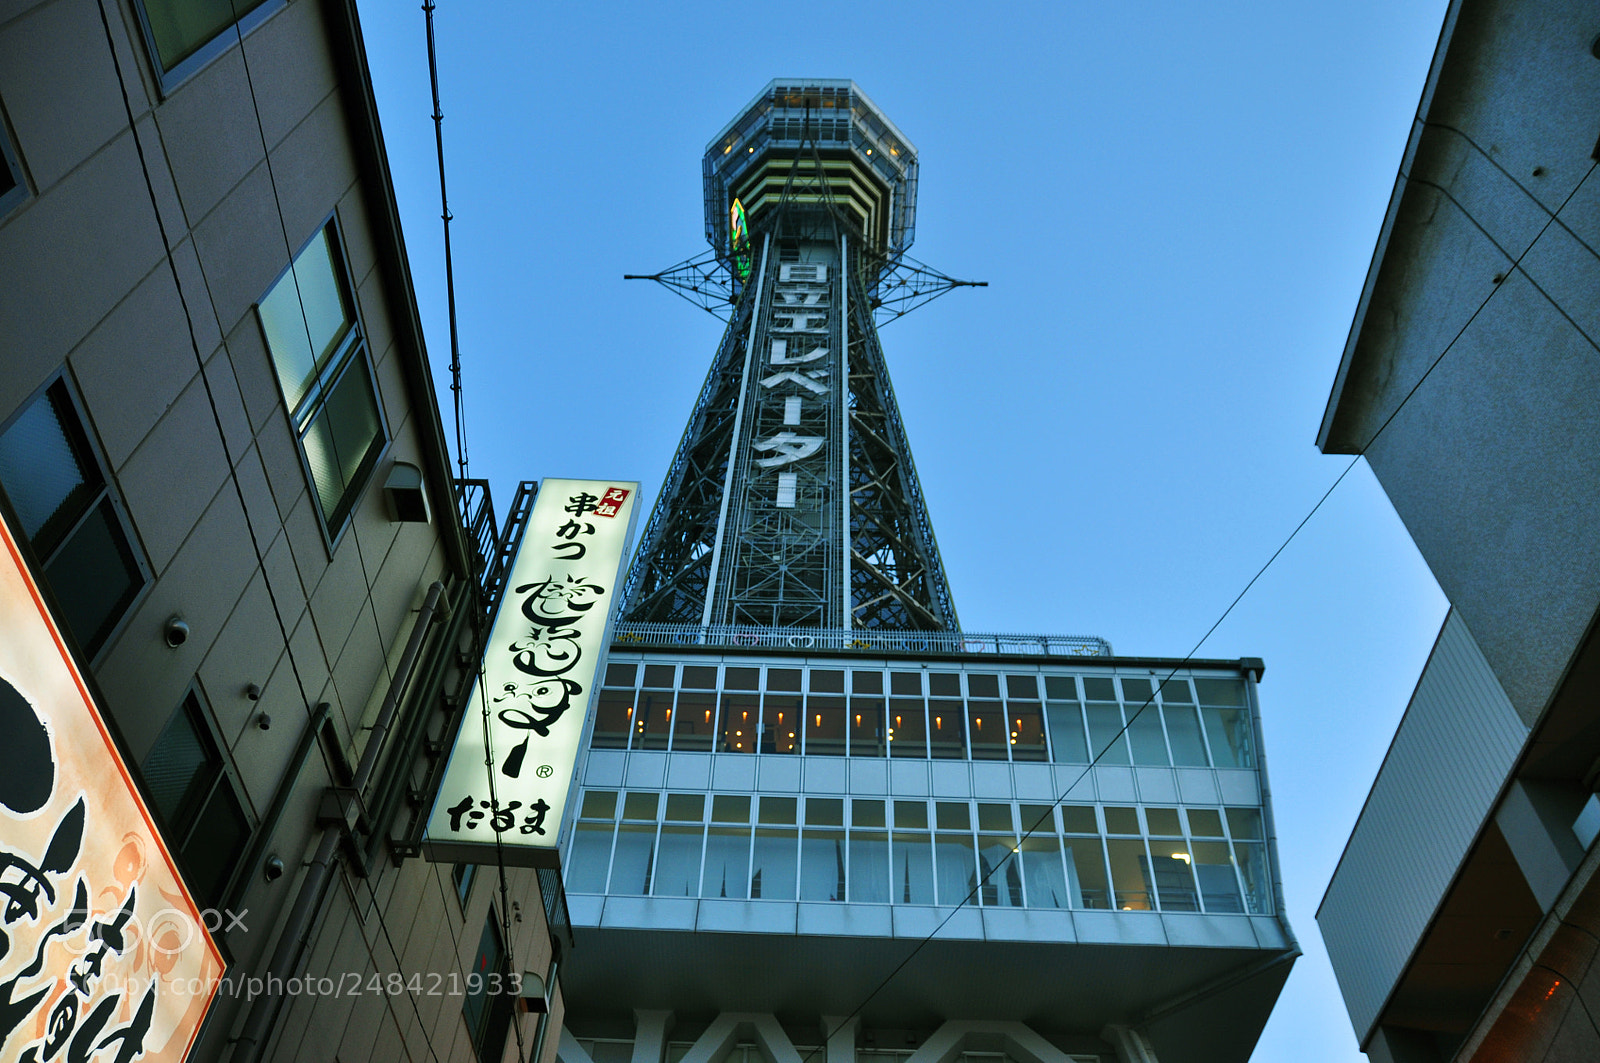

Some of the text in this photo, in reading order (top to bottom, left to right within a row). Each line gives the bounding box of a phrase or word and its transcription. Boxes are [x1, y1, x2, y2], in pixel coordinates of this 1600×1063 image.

[596, 489, 625, 517] 元祖
[552, 492, 599, 560] 串かつ
[447, 795, 551, 835] だるま
